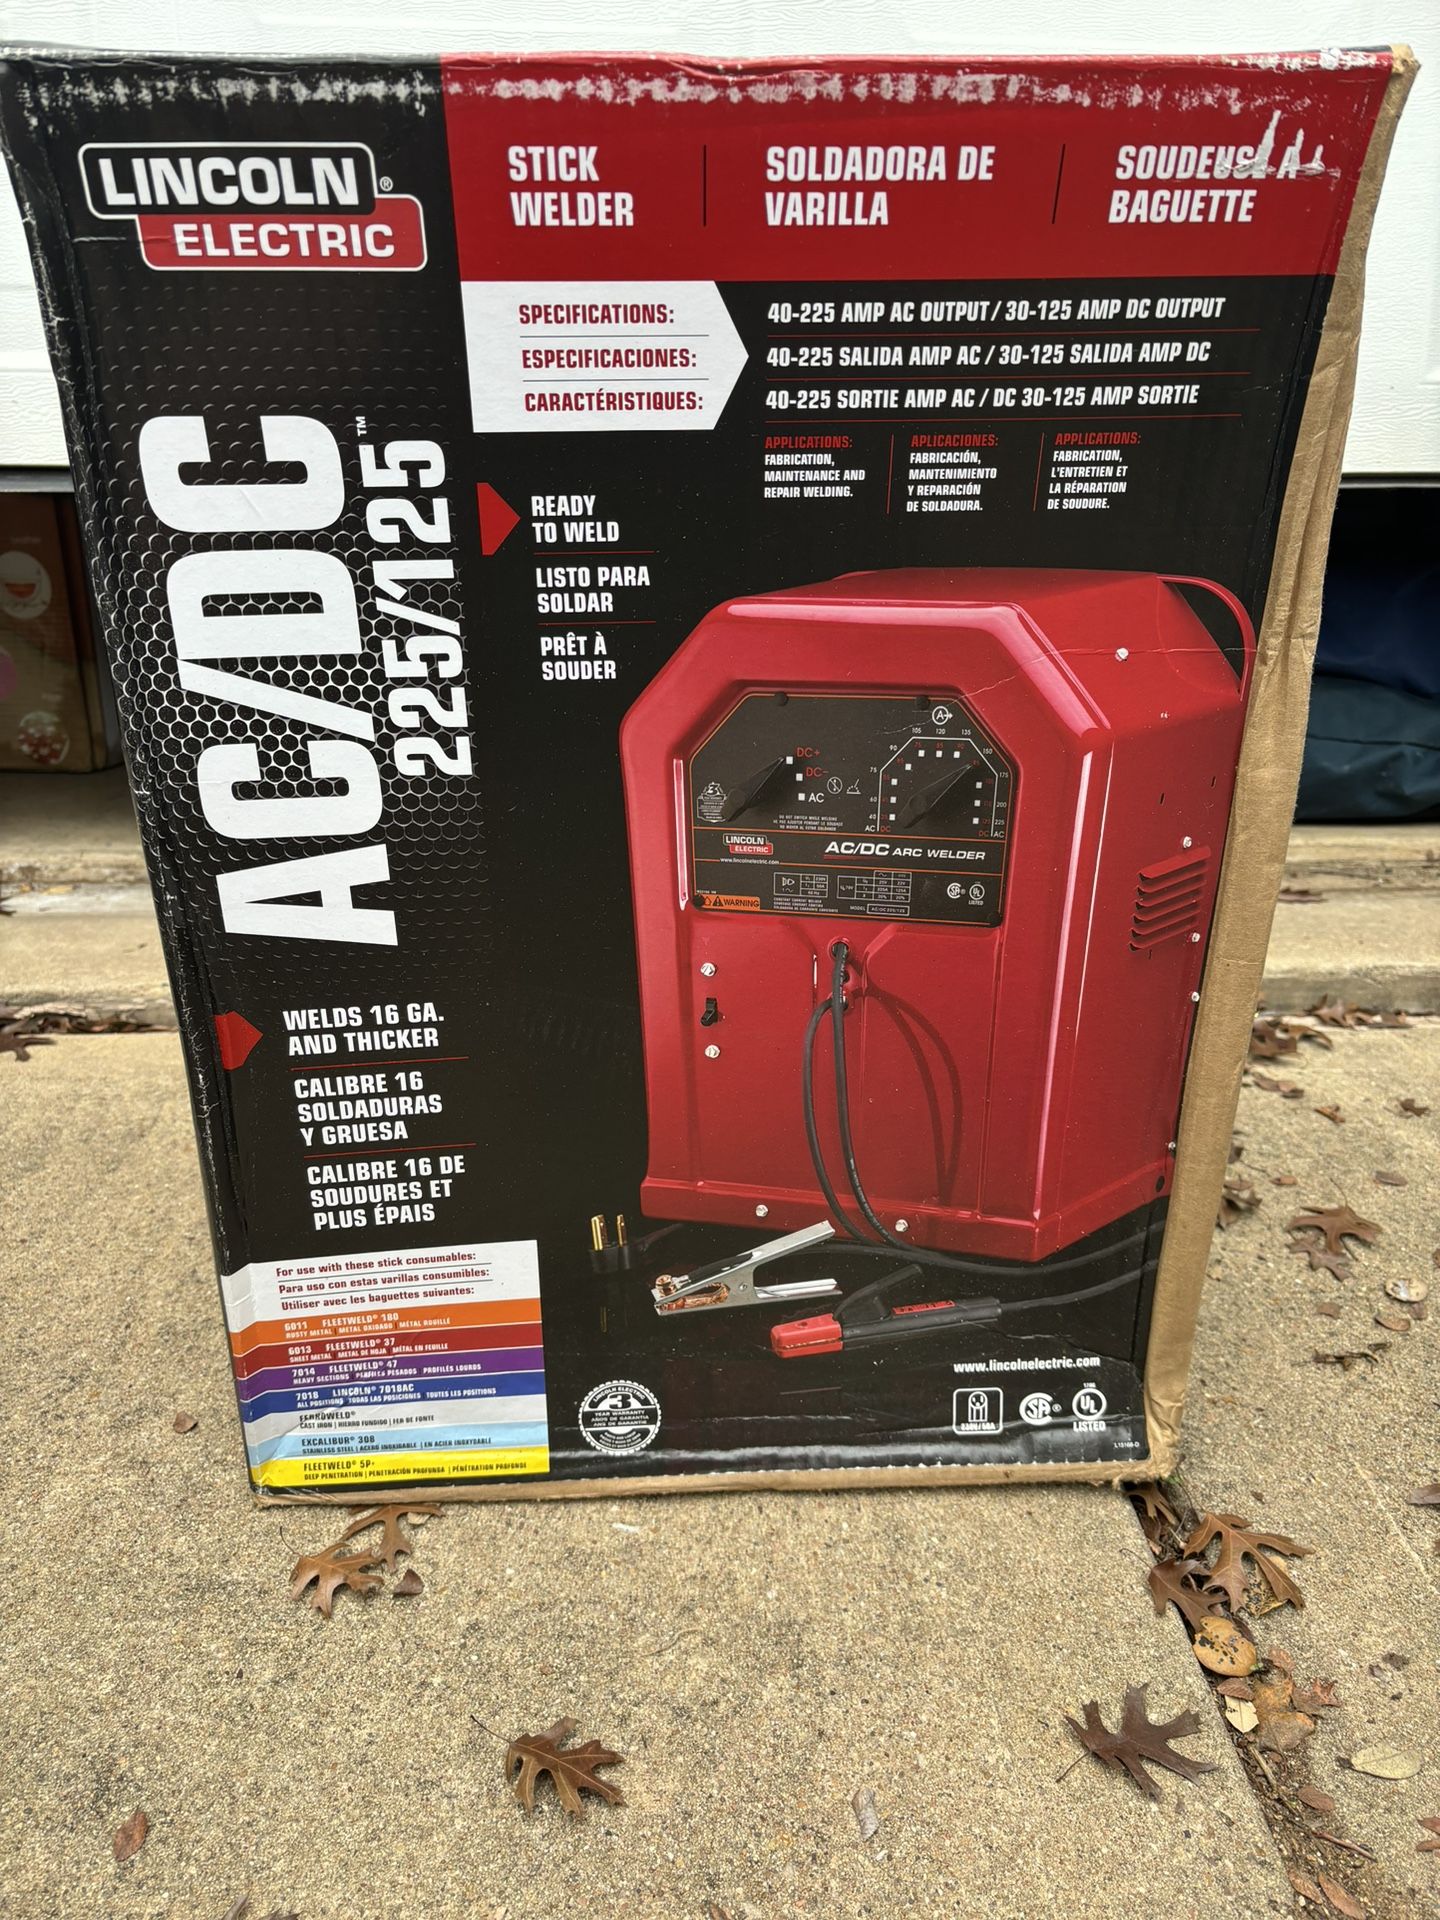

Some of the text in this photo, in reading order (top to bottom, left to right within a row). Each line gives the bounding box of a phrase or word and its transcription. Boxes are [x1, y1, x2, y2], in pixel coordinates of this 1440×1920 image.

[508, 145, 599, 182] STICK
[766, 145, 995, 182] SOLDADORA DE
[98, 156, 359, 206] LINCOLN
[510, 191, 634, 227] WELDER
[765, 190, 889, 227] VARILLA
[1108, 189, 1257, 223] BAGUETTE
[172, 223, 396, 258] ELECTRIC
[519, 304, 674, 324] SPECIFICATIONS:
[767, 302, 835, 323] 40-225
[841, 302, 885, 323] AMP
[890, 302, 915, 322] AC
[920, 301, 990, 322] OUTPUT
[1005, 299, 1072, 321] 30-125
[1077, 299, 1121, 320] AMP
[1125, 298, 1151, 319] DC
[1155, 297, 1226, 319] OUTPUT
[522, 349, 697, 369] ESPECIFICACIONES:
[766, 347, 833, 367] 40-225
[839, 346, 903, 366] SALIDA
[909, 346, 952, 366] AMP
[956, 345, 981, 365] AC
[998, 344, 1064, 365] 30-125
[1069, 343, 1132, 364] SALIDA
[1138, 342, 1182, 362] AMP
[1186, 342, 1211, 362] DC
[525, 388, 703, 412] CARACTÉRISTIQUES:
[765, 390, 831, 409] 40-225
[837, 389, 900, 409] SORTIE
[904, 388, 947, 409] AMP
[951, 388, 976, 408] AC
[993, 387, 1017, 407] DC
[1021, 386, 1086, 407] 30-125
[1090, 386, 1133, 406] AMP
[1137, 384, 1200, 405] SORTIE
[765, 436, 853, 449] APPLICATIONS:
[911, 434, 998, 447] APLICACIONES:
[1055, 432, 1141, 445] APPLICATIONS:
[764, 453, 835, 466] FABRICATION,
[910, 450, 982, 465] FABRICACIÓN,
[1053, 450, 1123, 463] FABRICATION,
[764, 469, 866, 482] MAINTENANCE AND
[908, 468, 997, 480] MANTENIMIENTO
[1051, 465, 1128, 478] L'ENTRETIEN ET
[764, 486, 853, 498] REPAIR WELDING.
[907, 482, 981, 496] Y REPARACIÓN
[1049, 480, 1127, 494] LA RÉPARATION
[531, 495, 596, 517] READY
[906, 499, 983, 512] DE SOLDADURA.
[1047, 498, 1110, 510] DE SOUDURE.
[532, 521, 620, 543] TO WELD
[536, 566, 650, 588] LISTO PARA
[358, 439, 473, 776] 225/125
[537, 592, 614, 613] SOLDAR
[540, 631, 607, 656] PRÊT À
[542, 660, 616, 680] SOUDER
[139, 415, 398, 946] AC/DC
[796, 747, 820, 757] DC+
[808, 793, 824, 803] AC
[725, 835, 764, 845] LINCOLN
[734, 845, 769, 853] ELECTRIC
[719, 857, 780, 865] www.lincolnelectric.com
[824, 841, 986, 861] AC/DC ARC WELDER
[723, 898, 760, 907] WARNING
[283, 1002, 444, 1031] WELDS 16 GA.
[288, 1027, 439, 1056] AND THICKER
[294, 1071, 423, 1099] CALIBRE 16
[298, 1094, 443, 1122] SOLDADURAS
[300, 1121, 408, 1146] Y GRUESA
[307, 1155, 465, 1185] CALIBRE 16 DE
[310, 1179, 452, 1208] SOUDURES ET
[314, 1203, 435, 1231] PLUS ÉPAIS
[276, 1253, 476, 1277] For use with these stick consumables:
[279, 1268, 489, 1294] Para uso con estas varillas consumibles:
[282, 1287, 474, 1311] Utiliser avec les baguettes suivantes:
[284, 1321, 308, 1332] 6011
[381, 1312, 399, 1322] 180
[288, 1346, 312, 1356] 6013
[384, 1337, 396, 1347] 37
[291, 1367, 316, 1378] 7014
[386, 1359, 398, 1369] 47
[953, 1356, 1101, 1373] www.lincolnelectric.com
[296, 1391, 319, 1401] 7018
[380, 1383, 414, 1394] 7018AC
[1072, 1420, 1107, 1432] LISTED
[358, 1435, 375, 1444] 308
